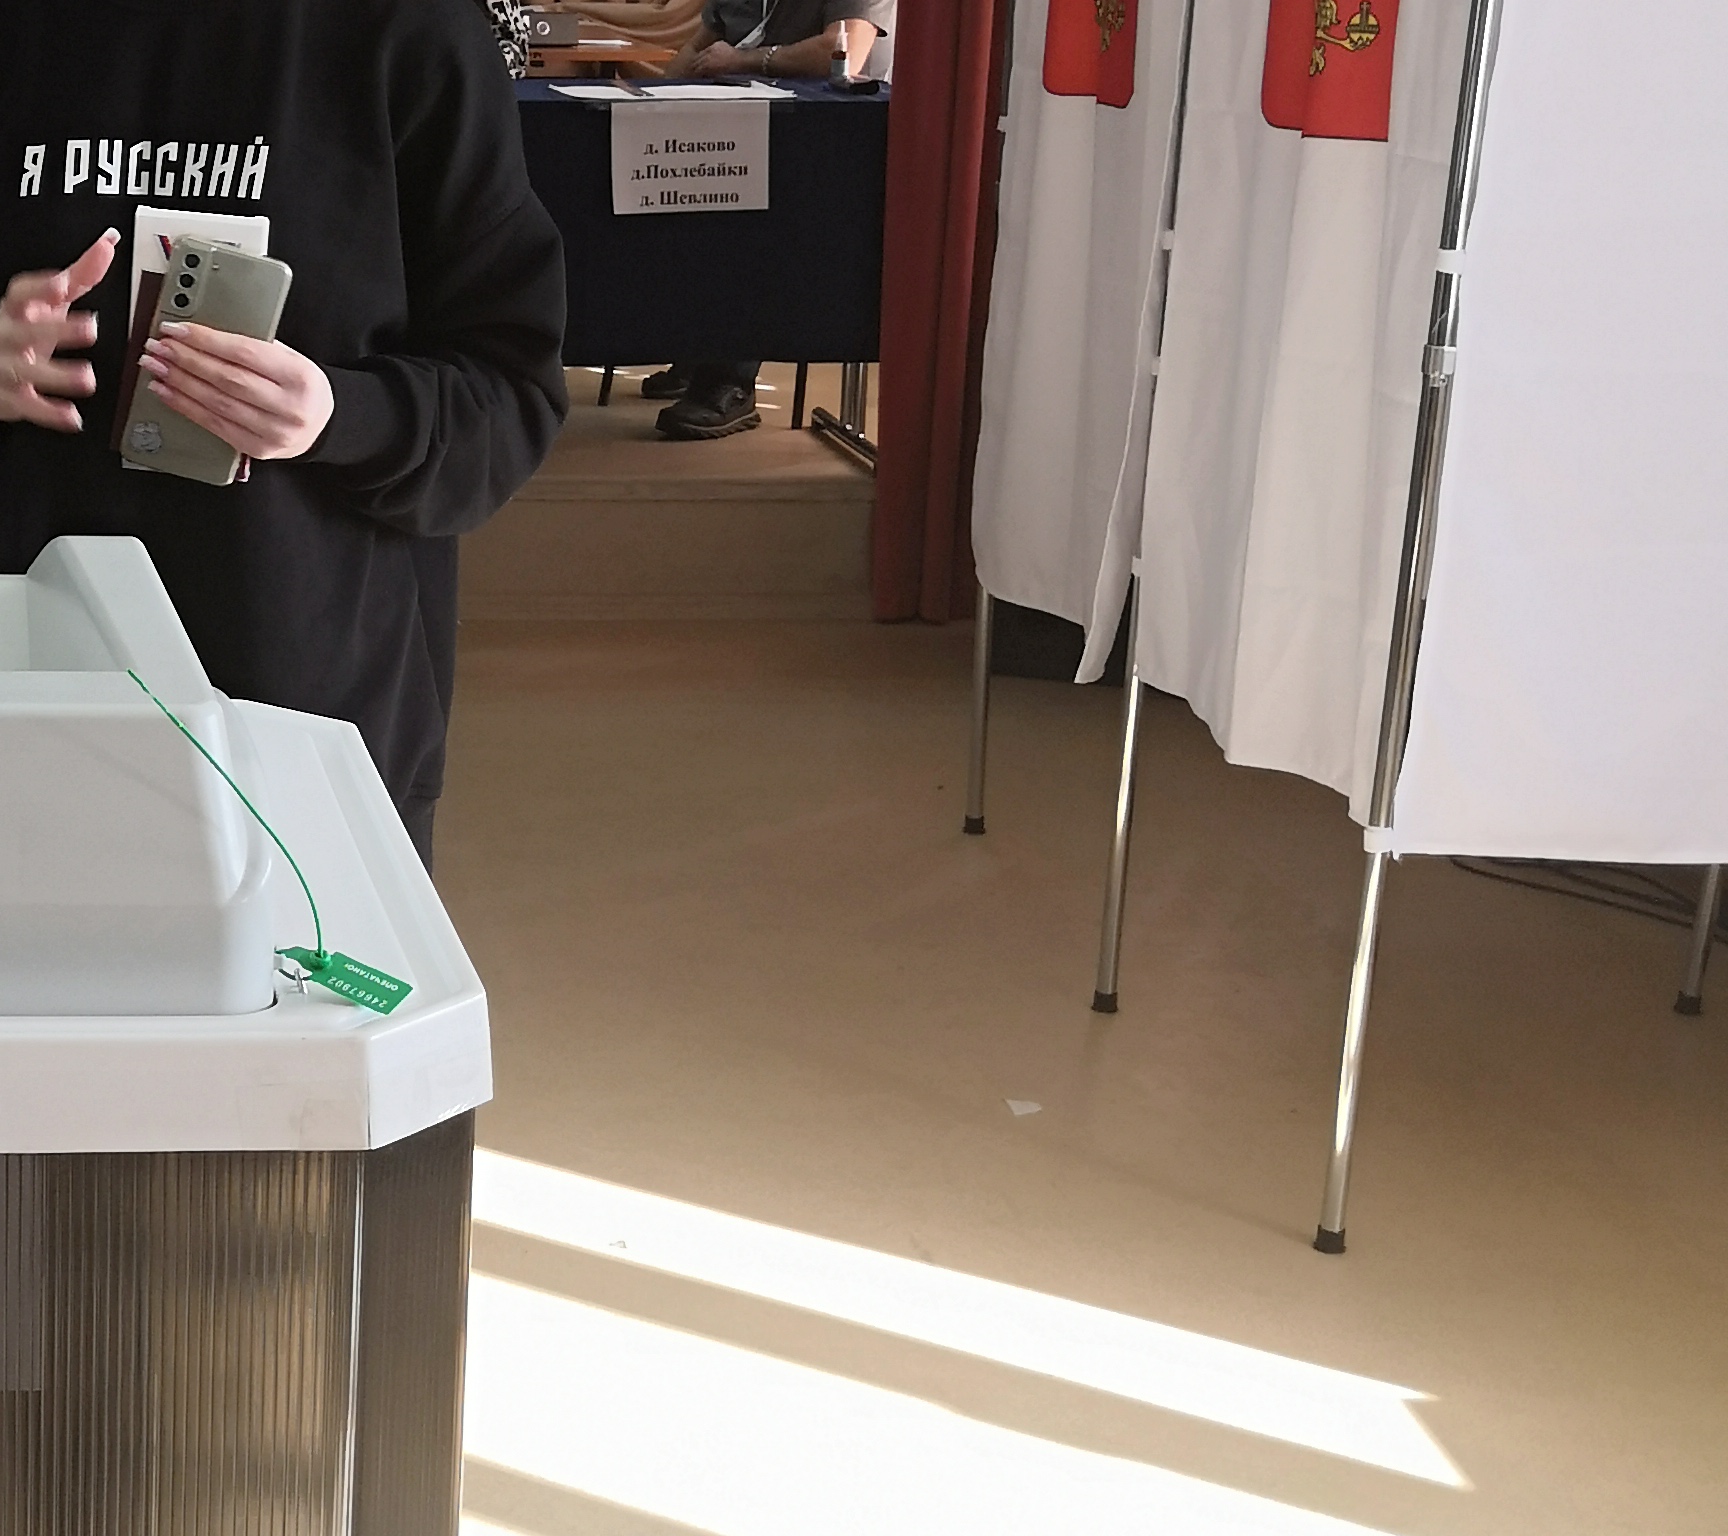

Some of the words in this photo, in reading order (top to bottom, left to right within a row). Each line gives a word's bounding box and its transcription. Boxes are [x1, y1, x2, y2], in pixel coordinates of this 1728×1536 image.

[643, 142, 659, 155] д.
[664, 138, 736, 154] Исаково
[20, 144, 46, 197] Я
[64, 135, 269, 200] РУССКИЙ
[639, 194, 654, 207] д.
[660, 191, 740, 206] Шевлино
